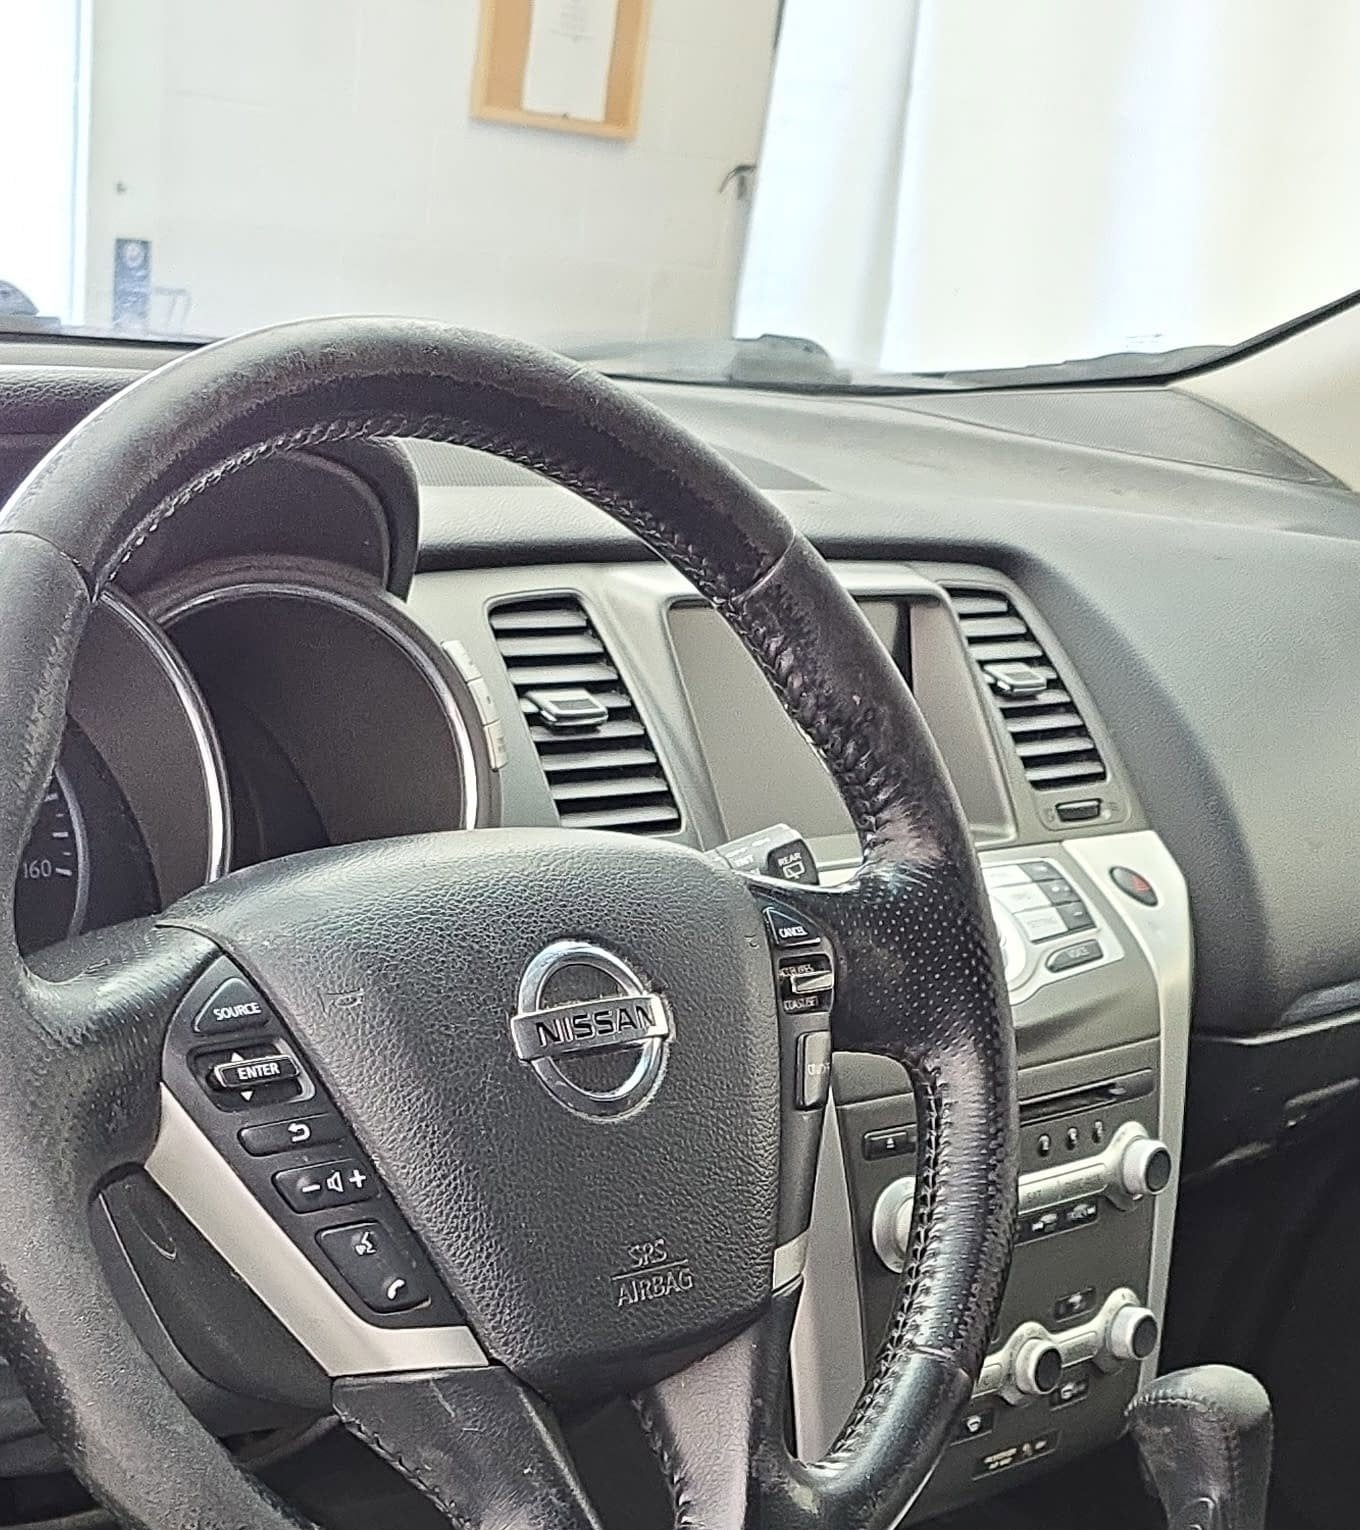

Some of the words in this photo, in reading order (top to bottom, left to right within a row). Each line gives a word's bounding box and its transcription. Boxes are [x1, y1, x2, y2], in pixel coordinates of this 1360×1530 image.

[776, 852, 803, 866] REAR
[23, 859, 52, 879] 160
[778, 926, 808, 939] CANCEL
[213, 1002, 262, 1021] SOURCE
[535, 1004, 657, 1047] NISSAN
[237, 1062, 281, 1080] ENTER
[627, 1238, 668, 1269] SRS
[617, 1268, 694, 1308] AIRBAG
